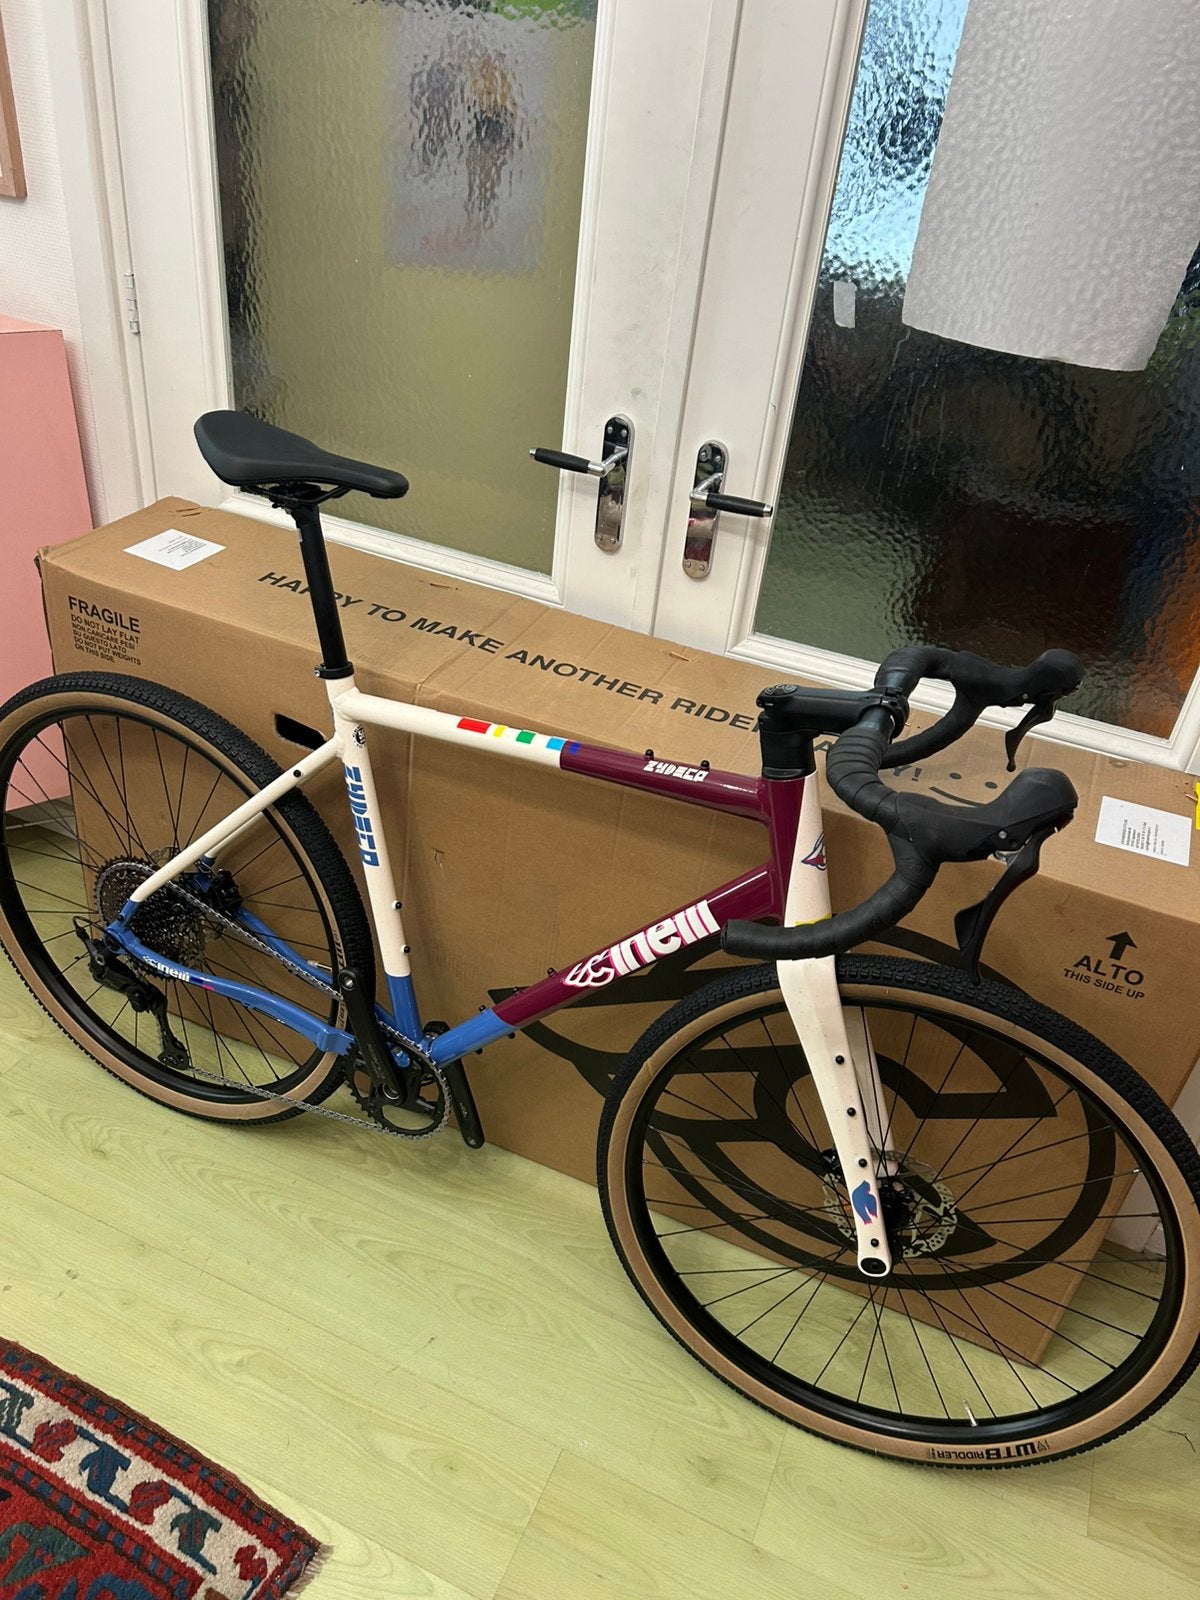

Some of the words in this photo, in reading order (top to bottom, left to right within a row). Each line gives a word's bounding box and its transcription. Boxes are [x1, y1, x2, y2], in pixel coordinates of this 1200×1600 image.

[68, 596, 140, 633] FRAGILE
[71, 614, 83, 624] DO
[84, 619, 100, 630] NOT
[101, 625, 118, 637] LAY
[119, 631, 140, 645] FLAT
[72, 622, 86, 632] NON
[87, 628, 119, 644] CARICARE
[120, 640, 136, 650] PESI
[74, 636, 84, 644] DO
[84, 640, 97, 649] NOT
[98, 645, 111, 654] PUT
[112, 650, 141, 666] WEIGHTS
[75, 643, 85, 651] ON
[85, 646, 99, 657] THIS
[82, 633, 109, 647] QUESTO
[109, 643, 127, 653] LATO
[258, 572, 363, 607] HAY
[367, 603, 407, 622] TO
[409, 617, 504, 654] MAKE
[505, 649, 664, 705] ANOTHER
[670, 697, 760, 733] RIDE
[1063, 968, 1092, 984] THIS
[1093, 978, 1125, 995] SIDE
[1125, 988, 1145, 999] UP
[1073, 954, 1145, 986] ALTO
[936, 1449, 985, 1460] RIDDLER
[985, 1442, 1037, 1460] WTB
